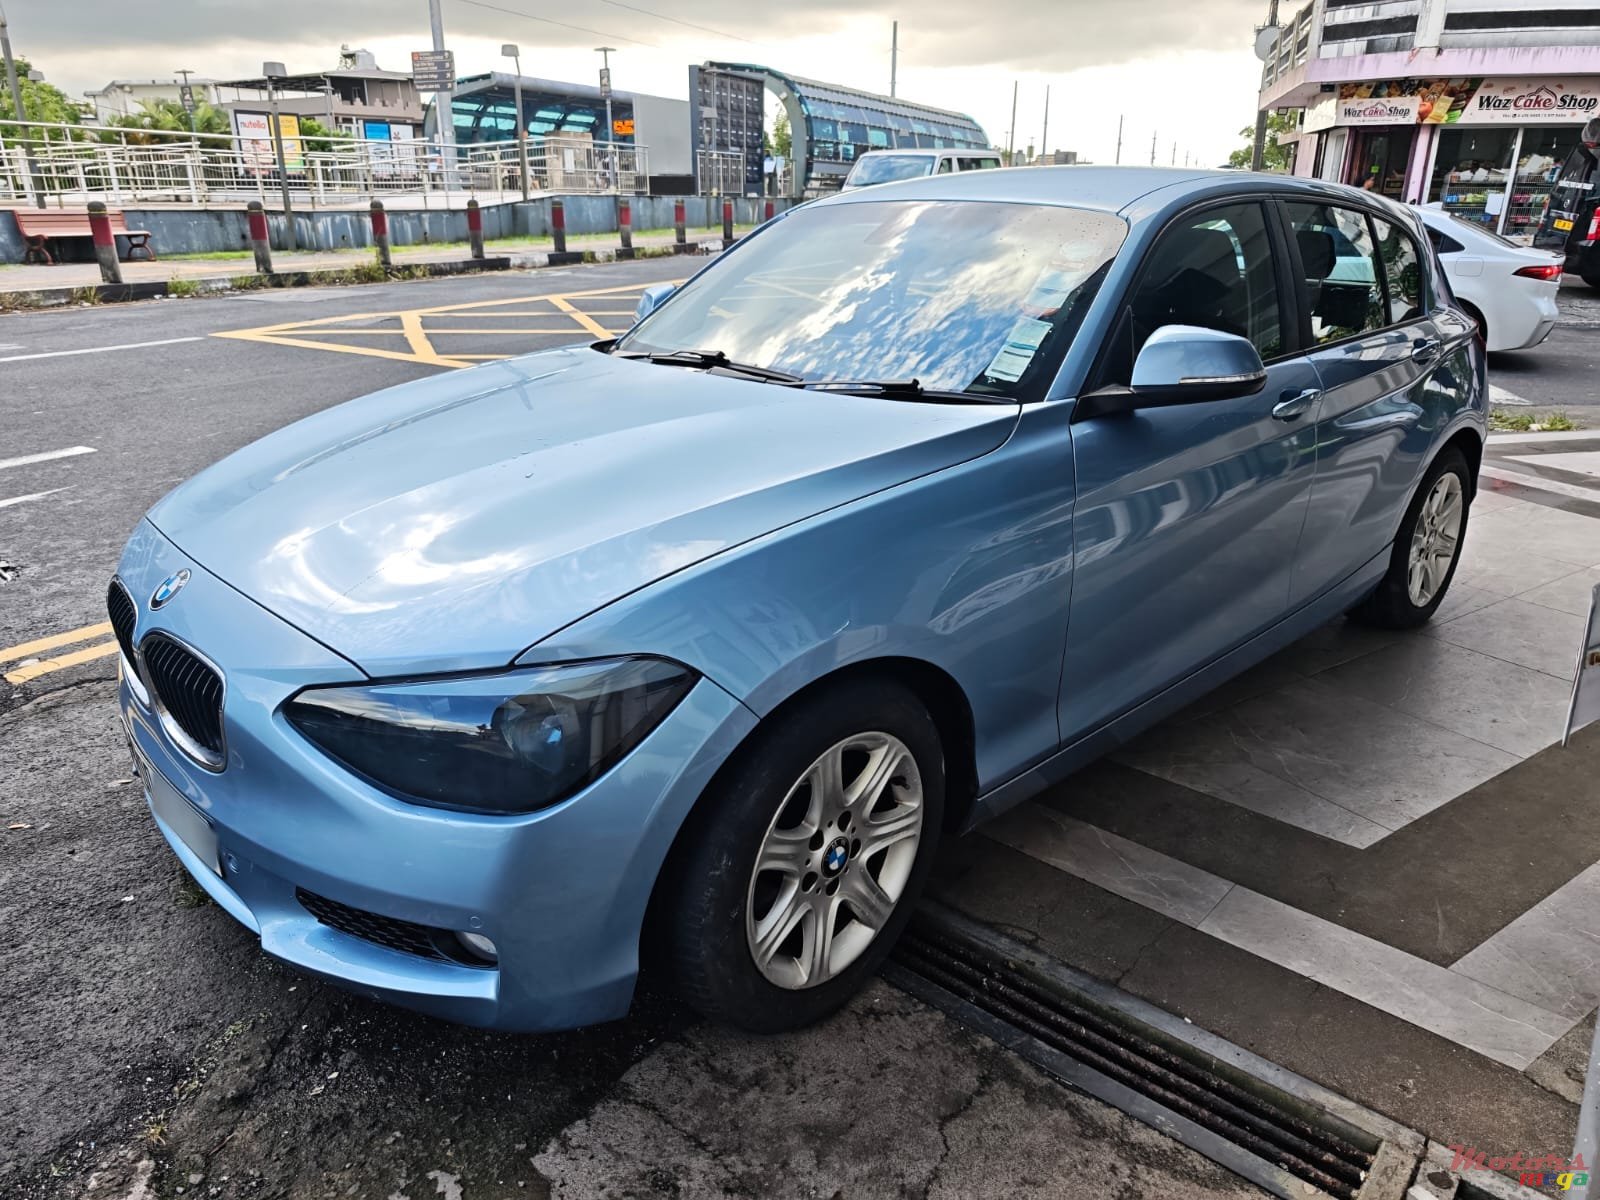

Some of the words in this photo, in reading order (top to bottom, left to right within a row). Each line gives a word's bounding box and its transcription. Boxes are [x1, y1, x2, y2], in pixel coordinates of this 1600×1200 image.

[1343, 107, 1362, 118] Waz
[1362, 105, 1386, 118] Cake
[1387, 106, 1411, 118] Shop
[1478, 95, 1511, 110] Waz
[1512, 94, 1555, 110] Cake
[1556, 94, 1598, 113] Shop
